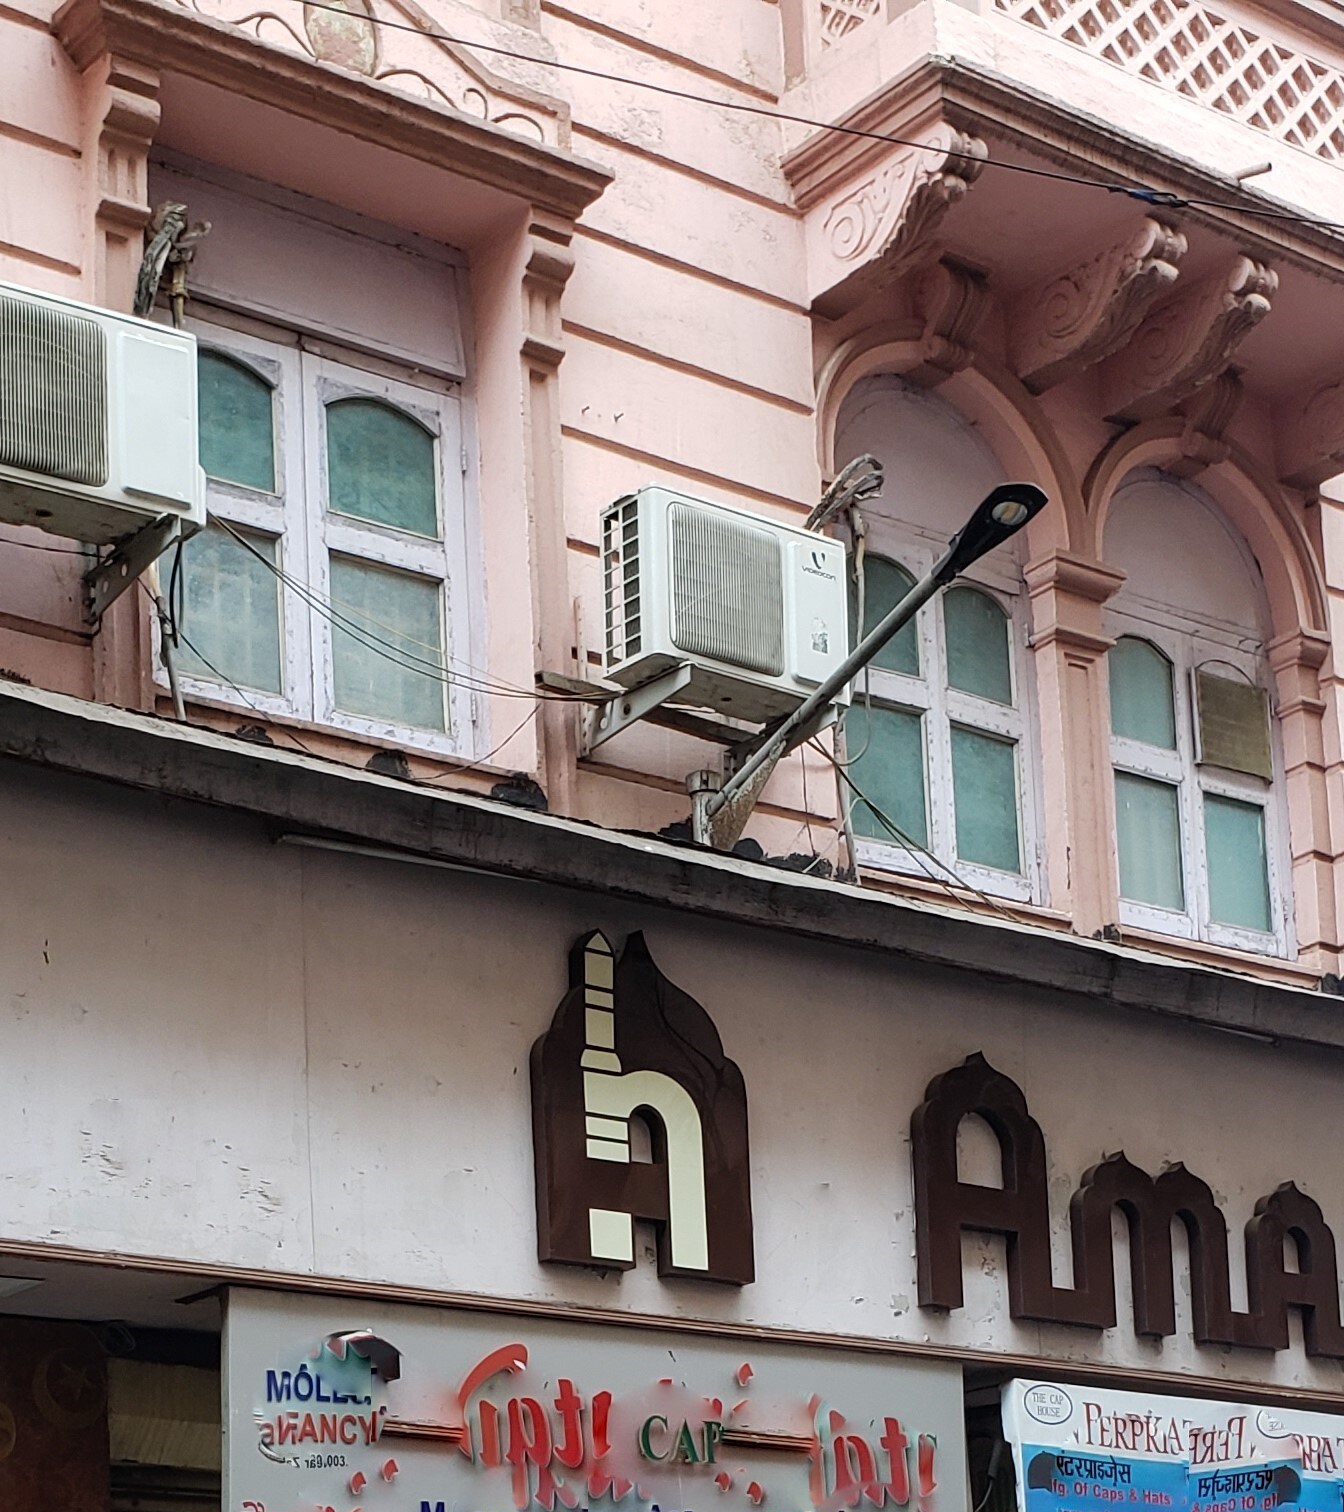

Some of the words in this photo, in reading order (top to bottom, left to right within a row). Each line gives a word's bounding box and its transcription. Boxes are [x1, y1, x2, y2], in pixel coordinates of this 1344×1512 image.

[1032, 1392, 1047, 1404] THE
[1050, 1394, 1064, 1405] CAP
[1037, 1406, 1061, 1418] HOUSE
[1074, 1482, 1087, 1495] Of
[1093, 1484, 1124, 1502] Caps
